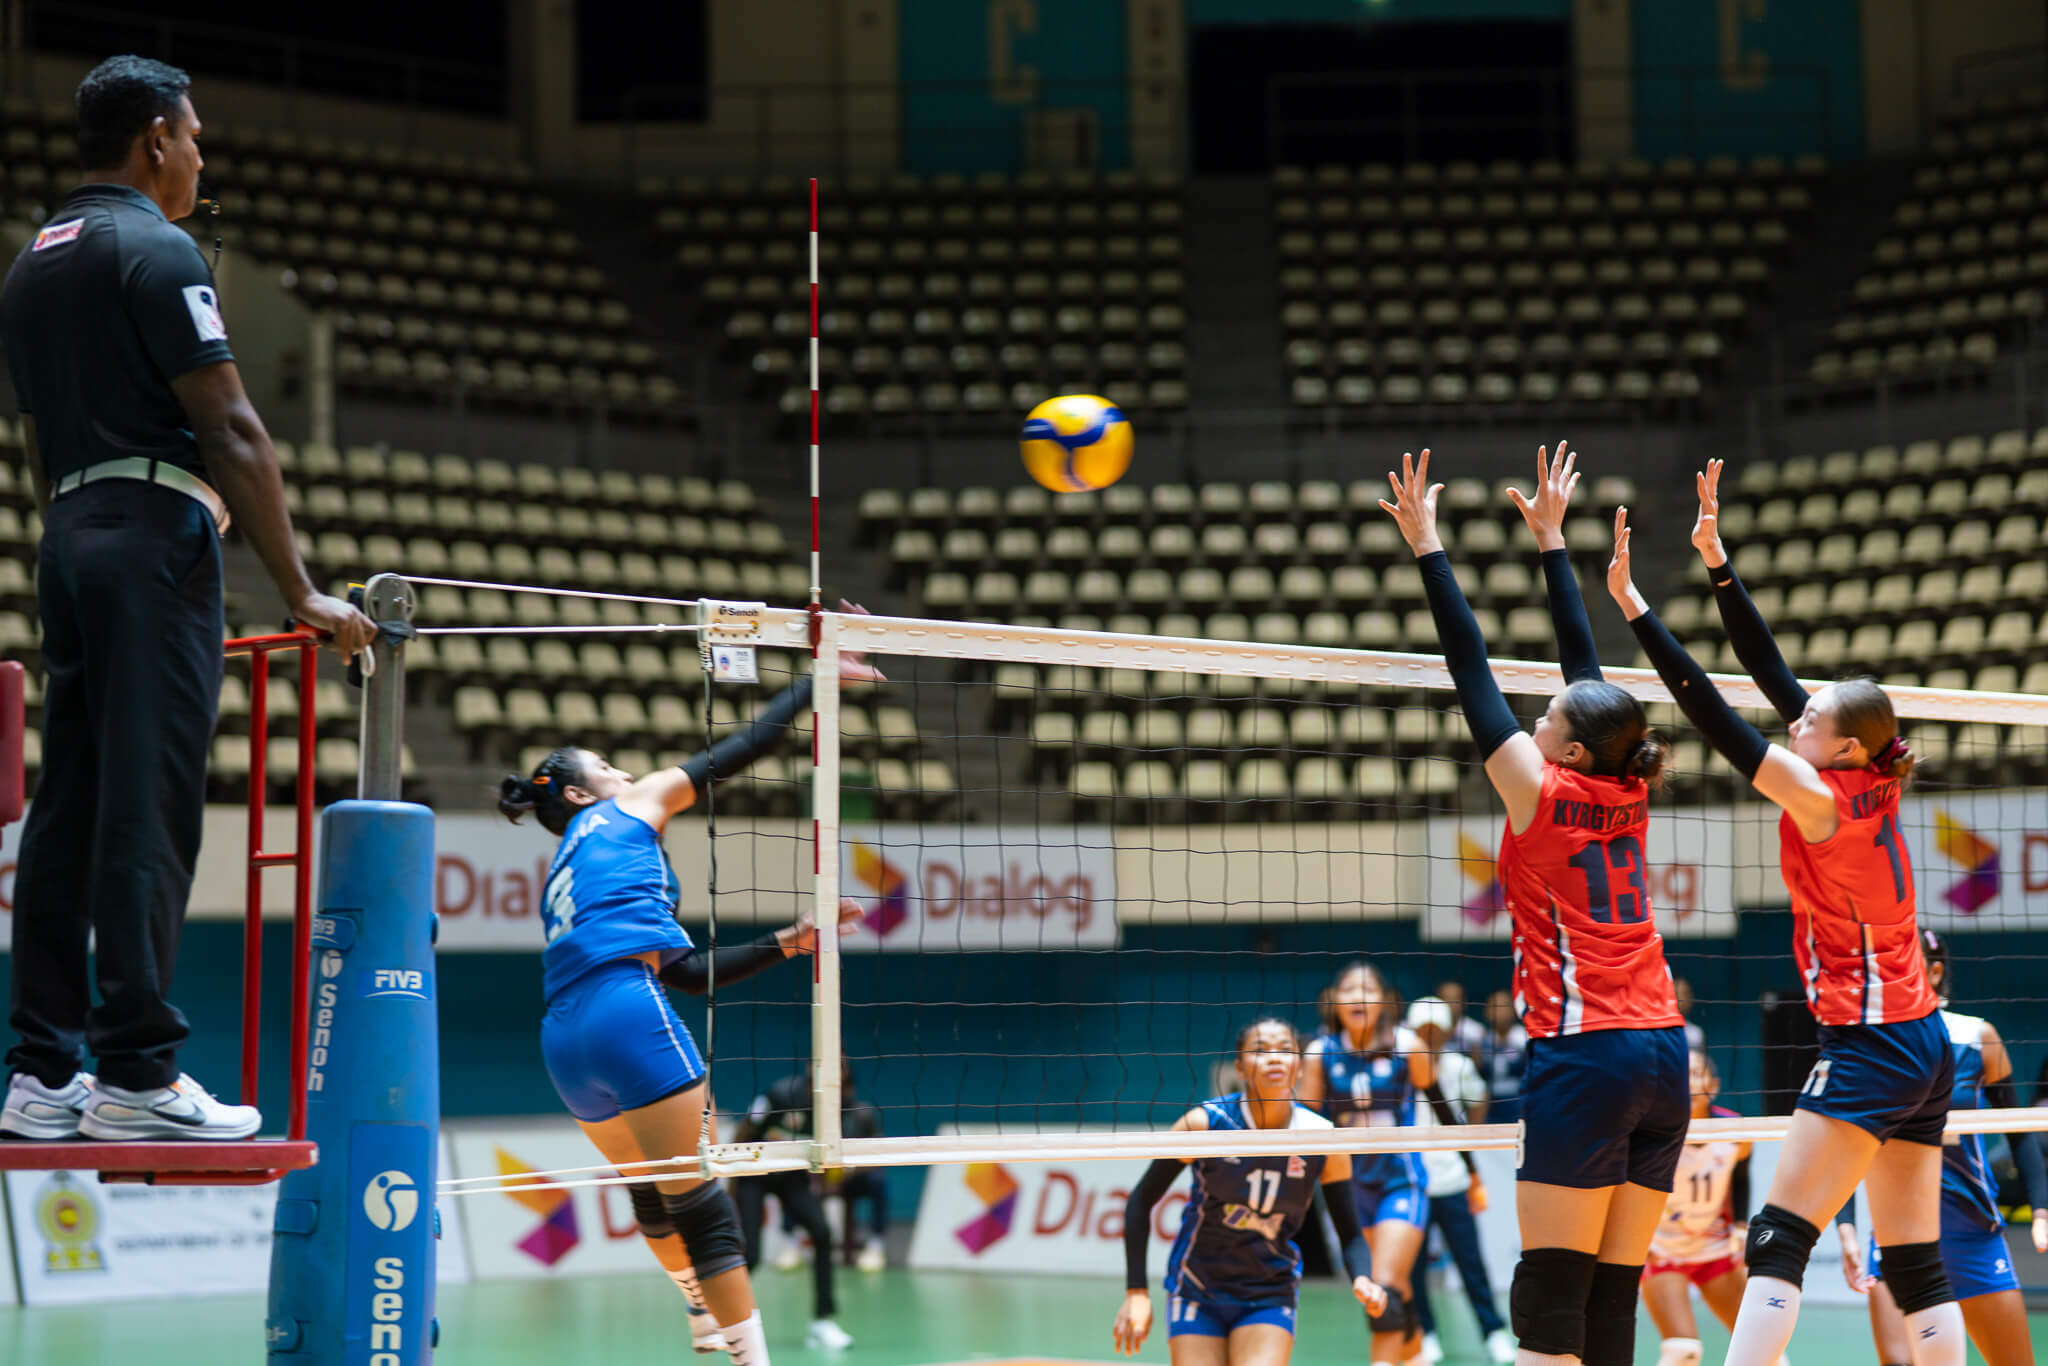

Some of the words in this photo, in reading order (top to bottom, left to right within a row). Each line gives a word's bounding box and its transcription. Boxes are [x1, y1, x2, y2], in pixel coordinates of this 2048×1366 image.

[924, 861, 1094, 932] Dialog
[1567, 836, 1648, 924] 13
[374, 969, 423, 990] FIVB
[307, 983, 337, 1092] Senoh
[1246, 1168, 1281, 1214] 17
